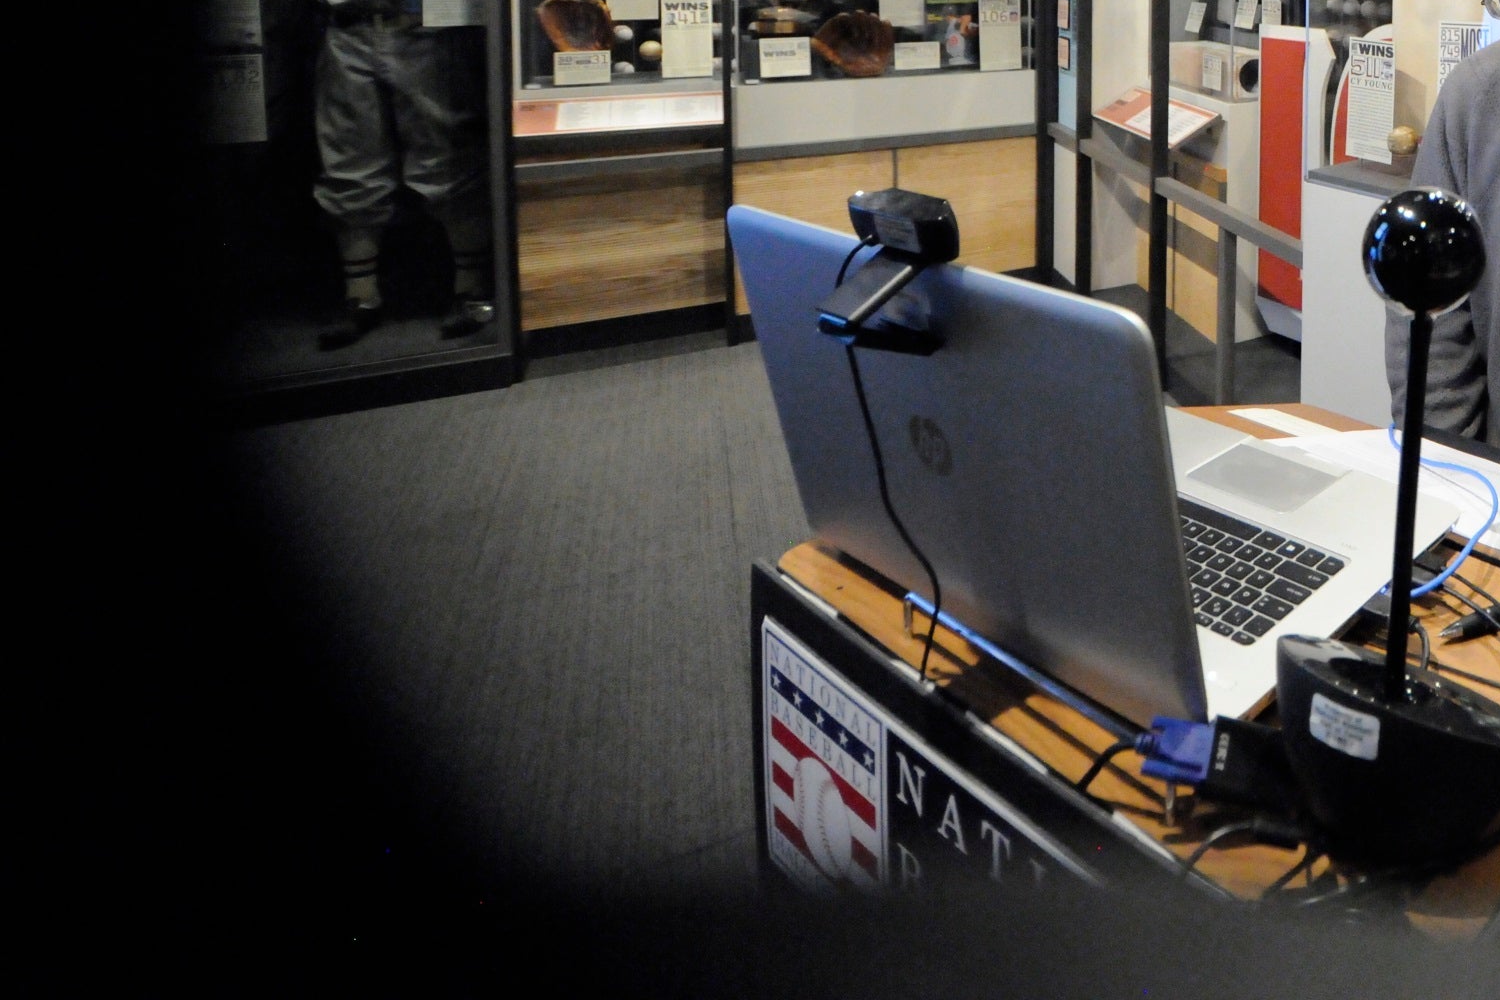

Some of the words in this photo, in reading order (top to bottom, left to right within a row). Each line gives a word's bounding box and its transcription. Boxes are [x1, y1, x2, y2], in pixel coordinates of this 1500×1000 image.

[664, 2, 709, 11] WINS
[677, 11, 699, 25] 41
[1441, 29, 1461, 42] 815
[1358, 43, 1394, 58] WINS
[1441, 45, 1460, 58] 749
[1351, 57, 1381, 79] 511
[1364, 79, 1393, 90] YOUNG
[770, 640, 876, 744] NATIONAL
[770, 692, 876, 800] BASEBALL
